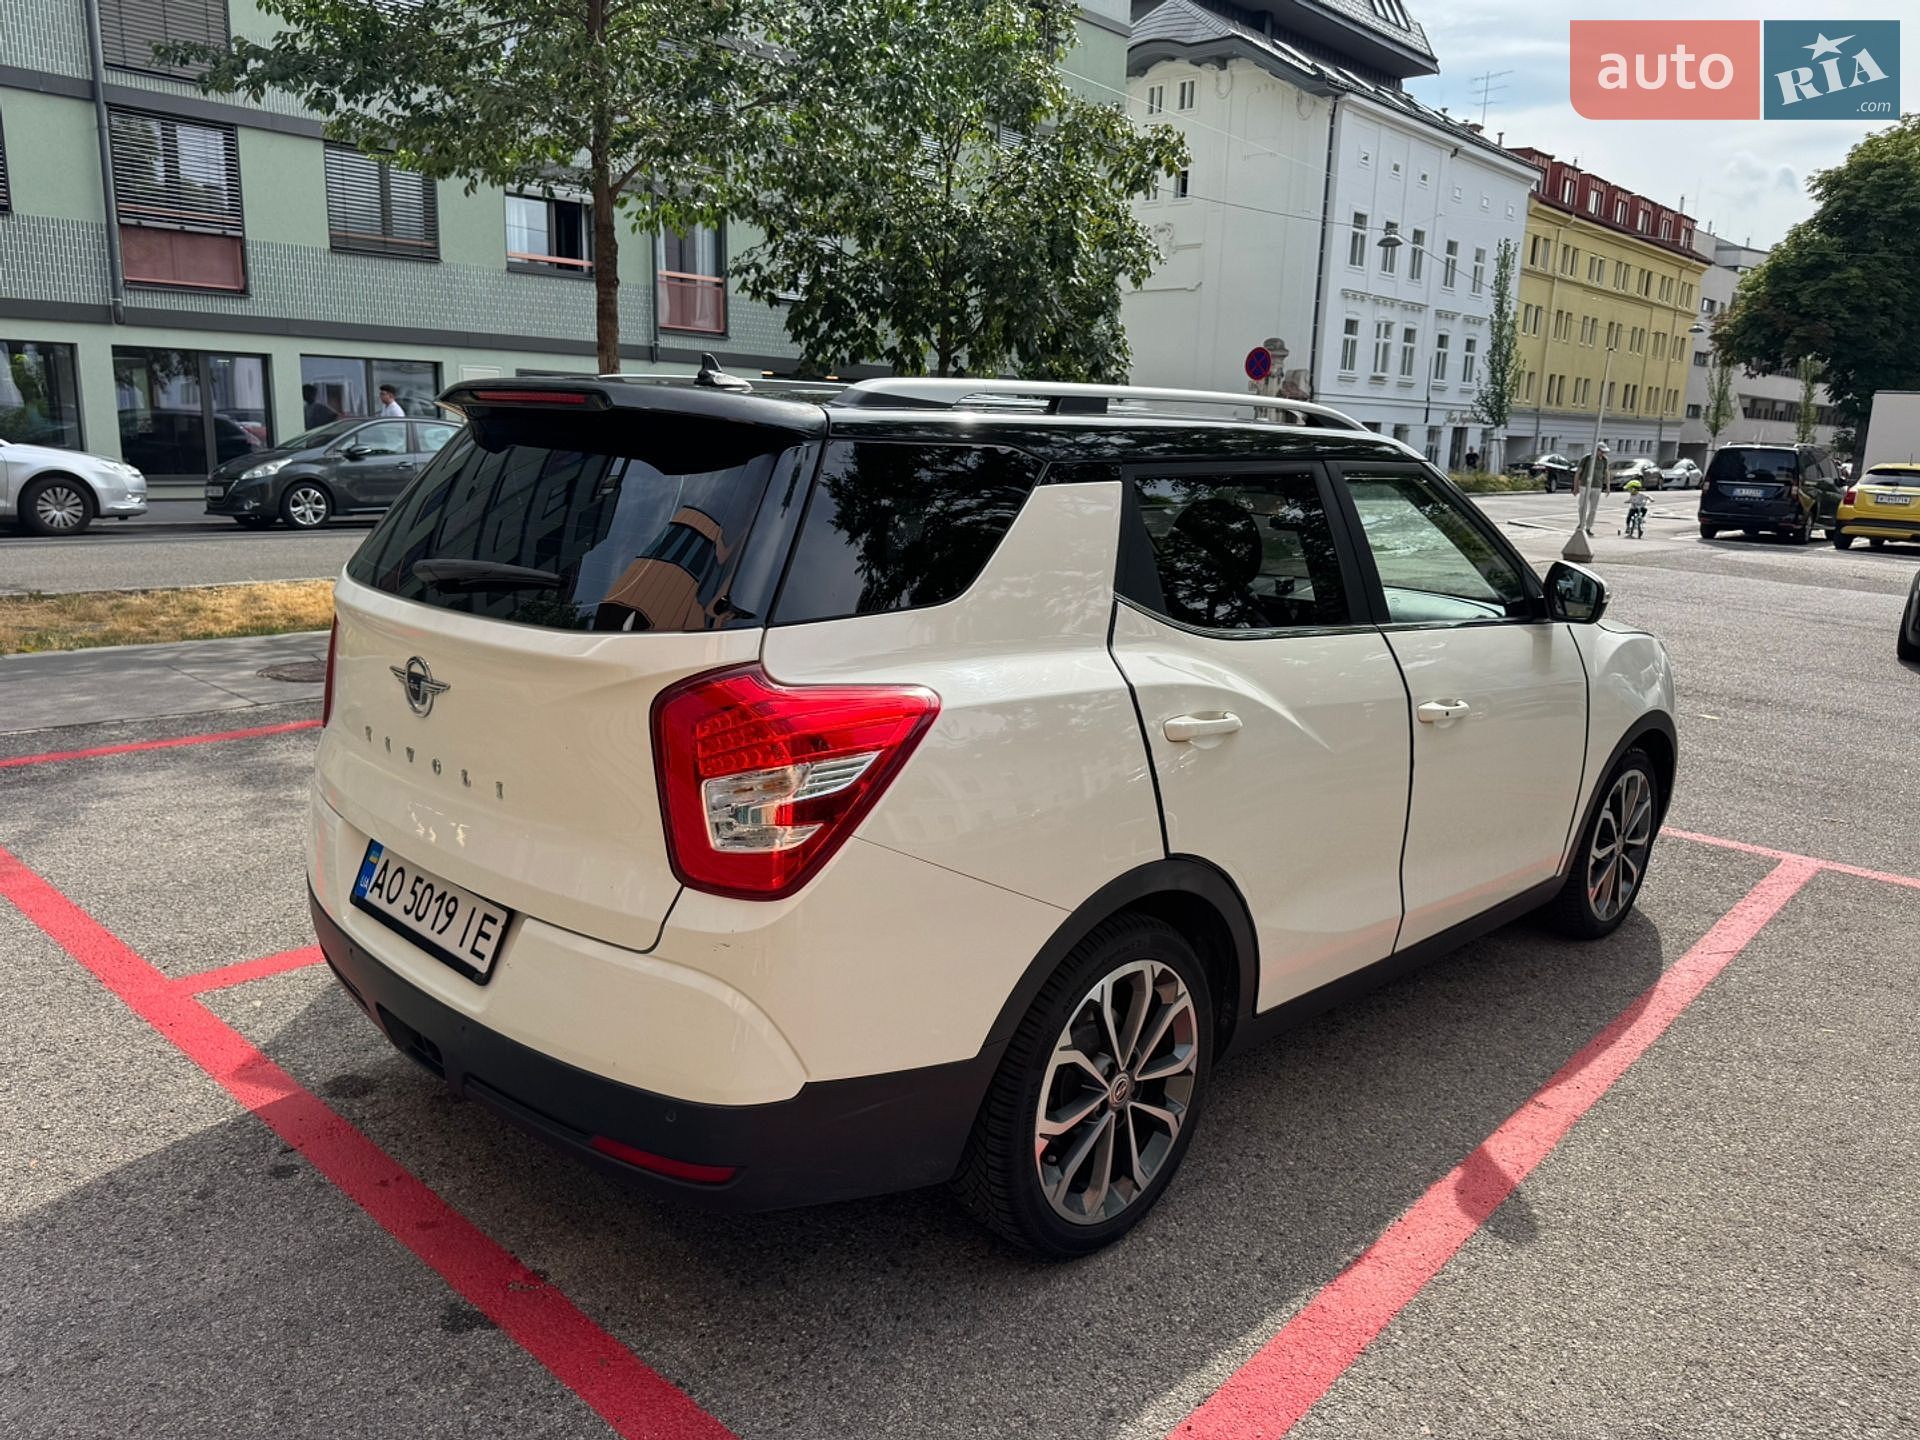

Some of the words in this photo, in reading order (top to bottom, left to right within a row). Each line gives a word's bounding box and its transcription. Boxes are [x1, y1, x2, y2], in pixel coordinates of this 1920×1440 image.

[364, 725, 504, 800] TIVOLI
[369, 858, 406, 905] AO
[403, 875, 459, 936] 5019
[458, 906, 499, 962] IE
